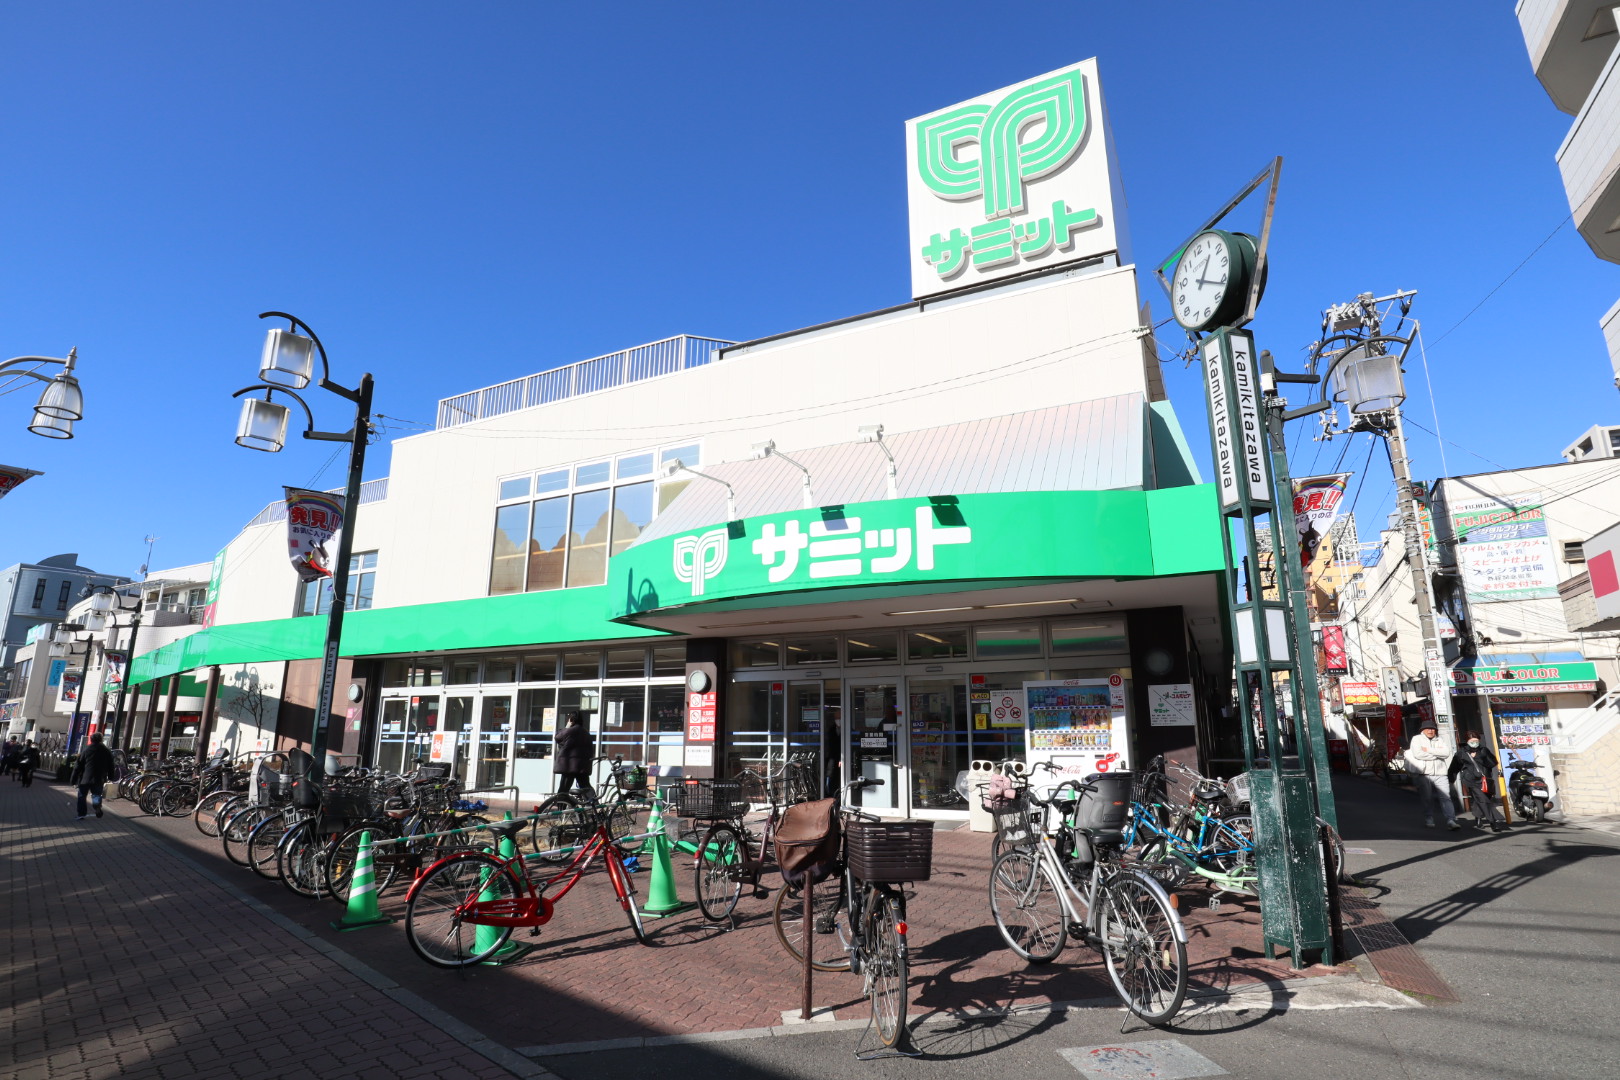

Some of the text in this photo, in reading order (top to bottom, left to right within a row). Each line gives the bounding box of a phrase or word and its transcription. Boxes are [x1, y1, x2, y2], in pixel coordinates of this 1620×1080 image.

[921, 199, 1097, 278] サミット
[1207, 240, 1211, 249] 1
[1193, 244, 1202, 257] 12
[1215, 243, 1223, 255] 2
[1184, 260, 1192, 273] 11
[1221, 256, 1228, 268] 3
[1179, 277, 1188, 290] 10
[1220, 273, 1227, 284] 4
[1179, 294, 1185, 305] 9
[1184, 306, 1190, 317] 8
[1193, 310, 1200, 322] 7
[1204, 307, 1211, 318] 6
[1209, 354, 1232, 488] kamikitazawa
[1236, 350, 1261, 483] kamikitazawa
[1455, 508, 1542, 527] FUJICOLOR
[752, 506, 971, 583] サミット
[1473, 668, 1560, 682] FUJICOLOR
